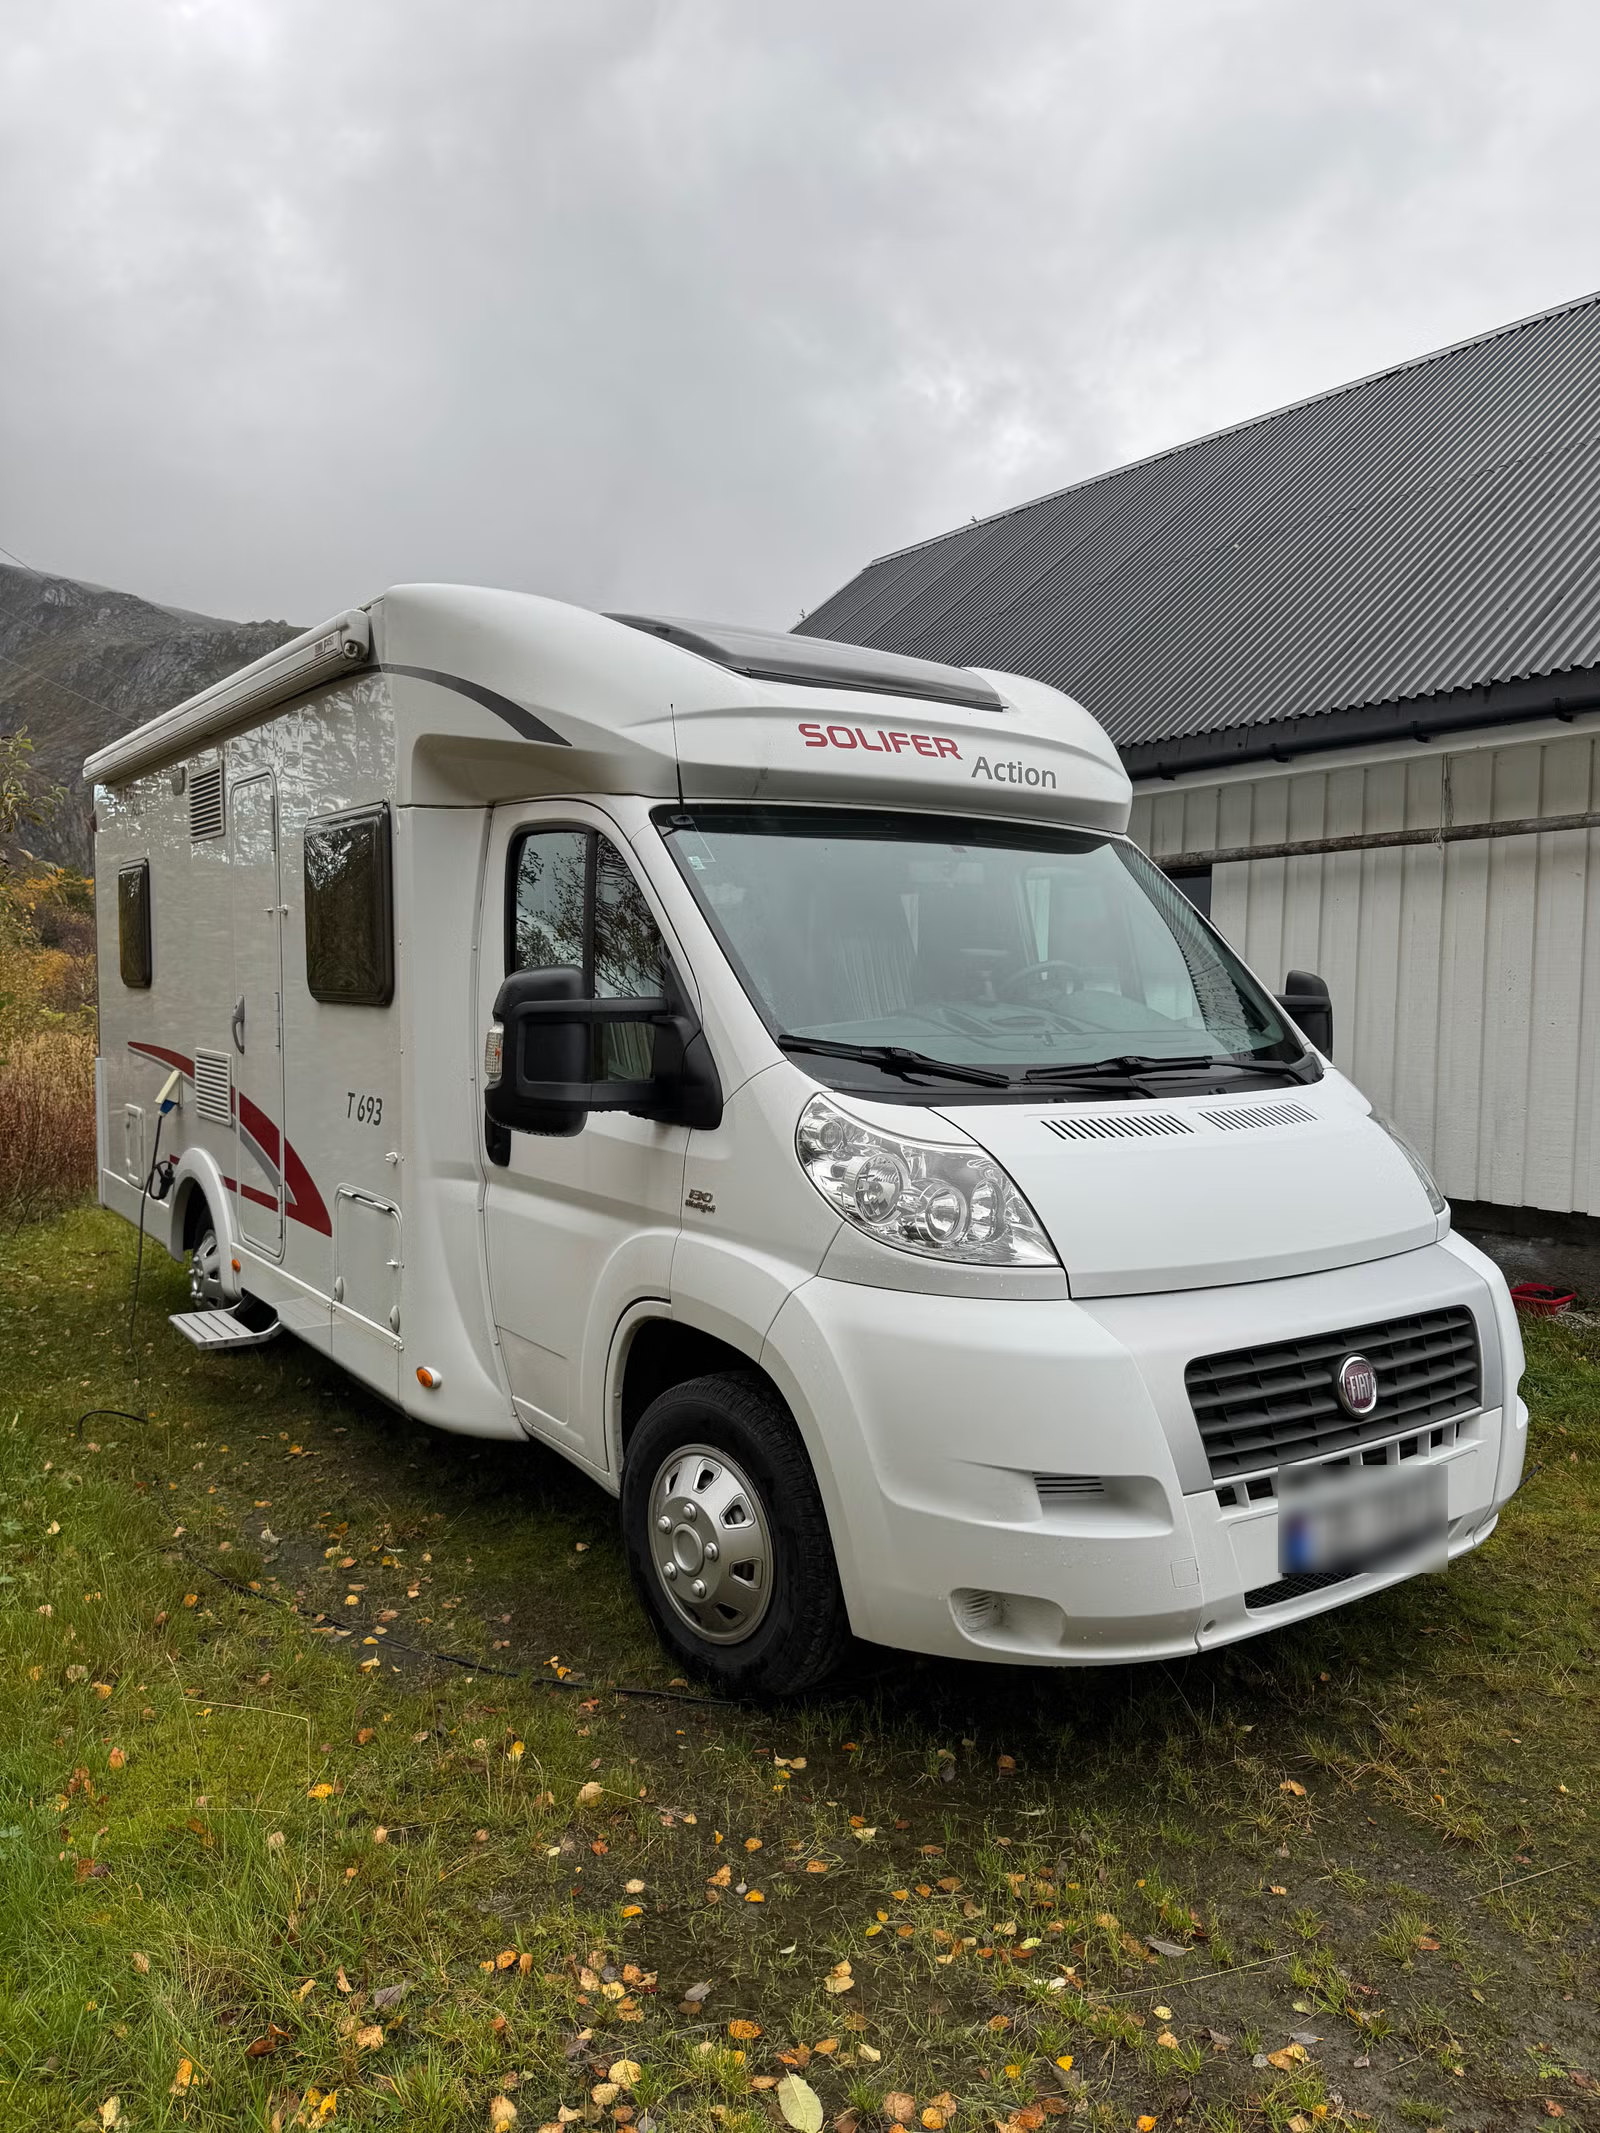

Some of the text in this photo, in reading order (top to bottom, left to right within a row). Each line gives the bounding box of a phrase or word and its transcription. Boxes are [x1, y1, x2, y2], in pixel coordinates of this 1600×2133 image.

[798, 723, 963, 760] SOLIFER
[971, 756, 1057, 789] Action
[347, 1092, 383, 1126] T 693
[1349, 1372, 1371, 1401] FIAT
